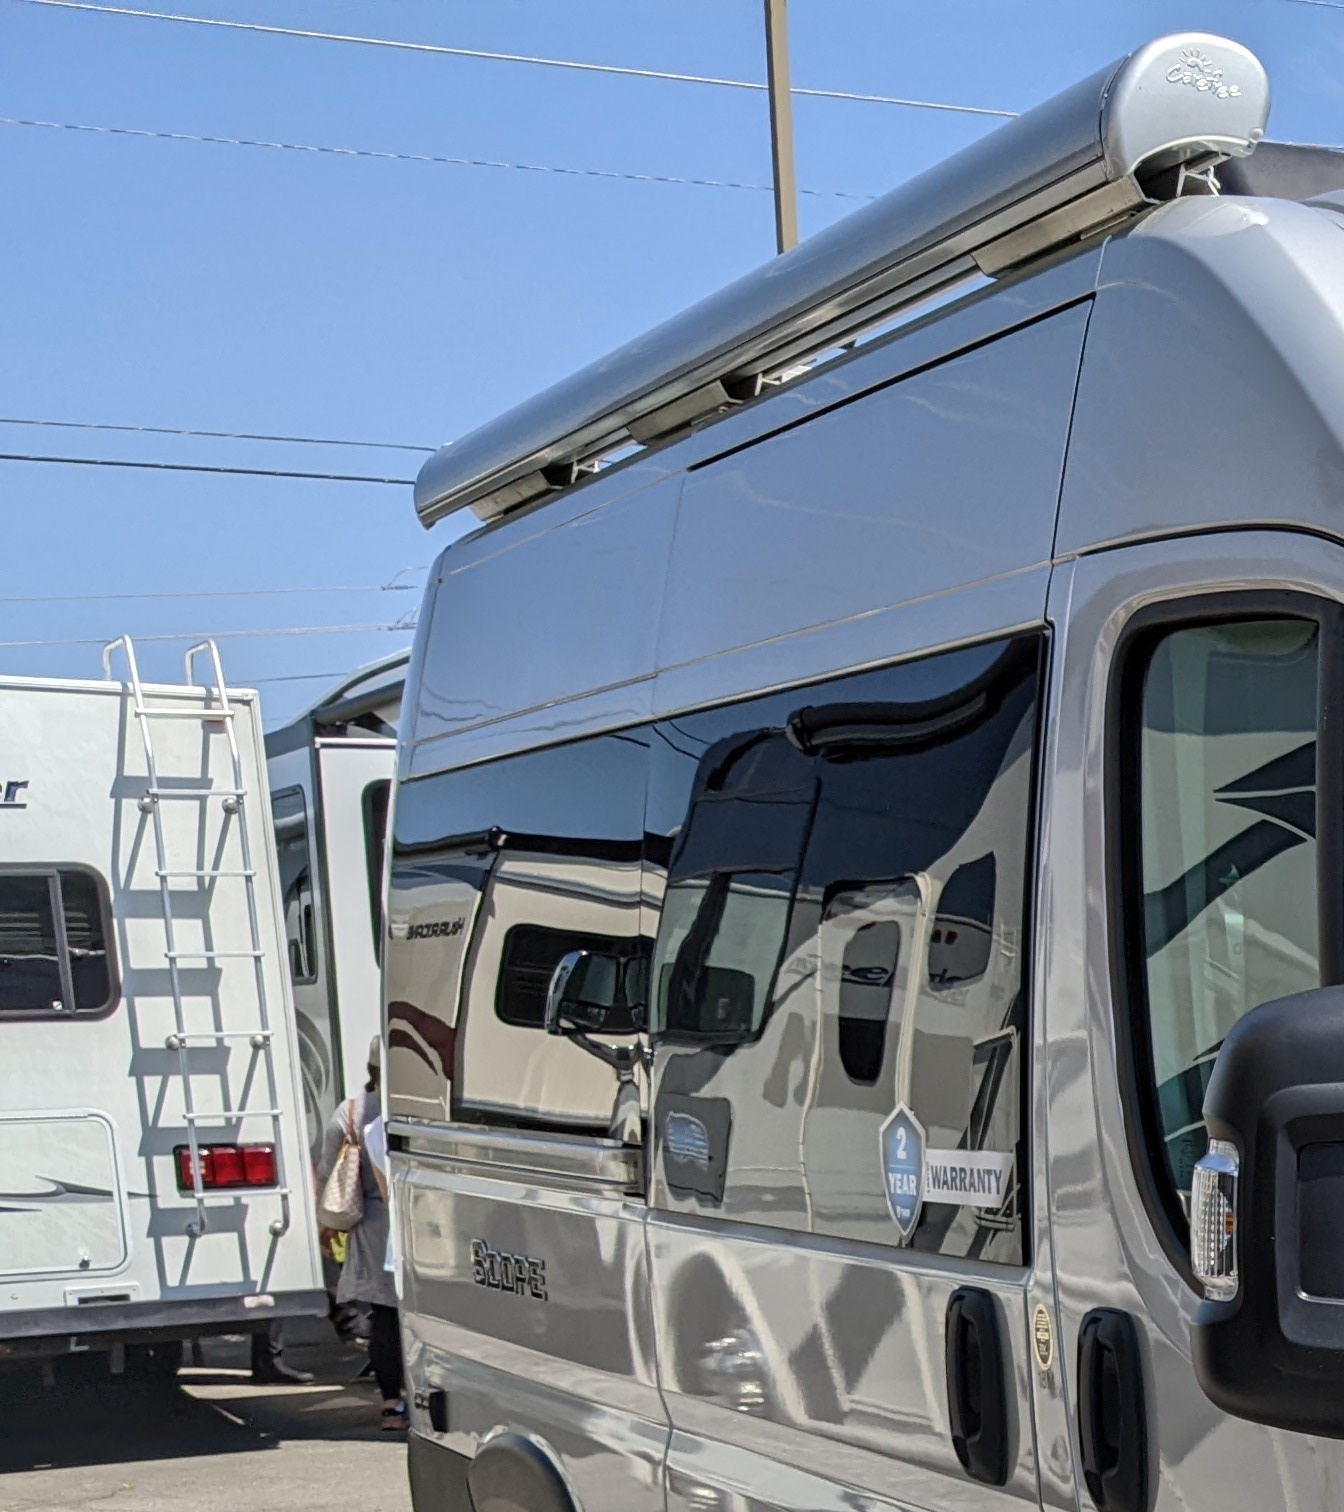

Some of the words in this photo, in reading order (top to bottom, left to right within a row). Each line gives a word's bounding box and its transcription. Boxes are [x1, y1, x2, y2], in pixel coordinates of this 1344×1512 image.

[896, 1127, 907, 1160] 2
[888, 1172, 917, 1196] YEAR
[930, 1165, 1003, 1196] WARRANTY
